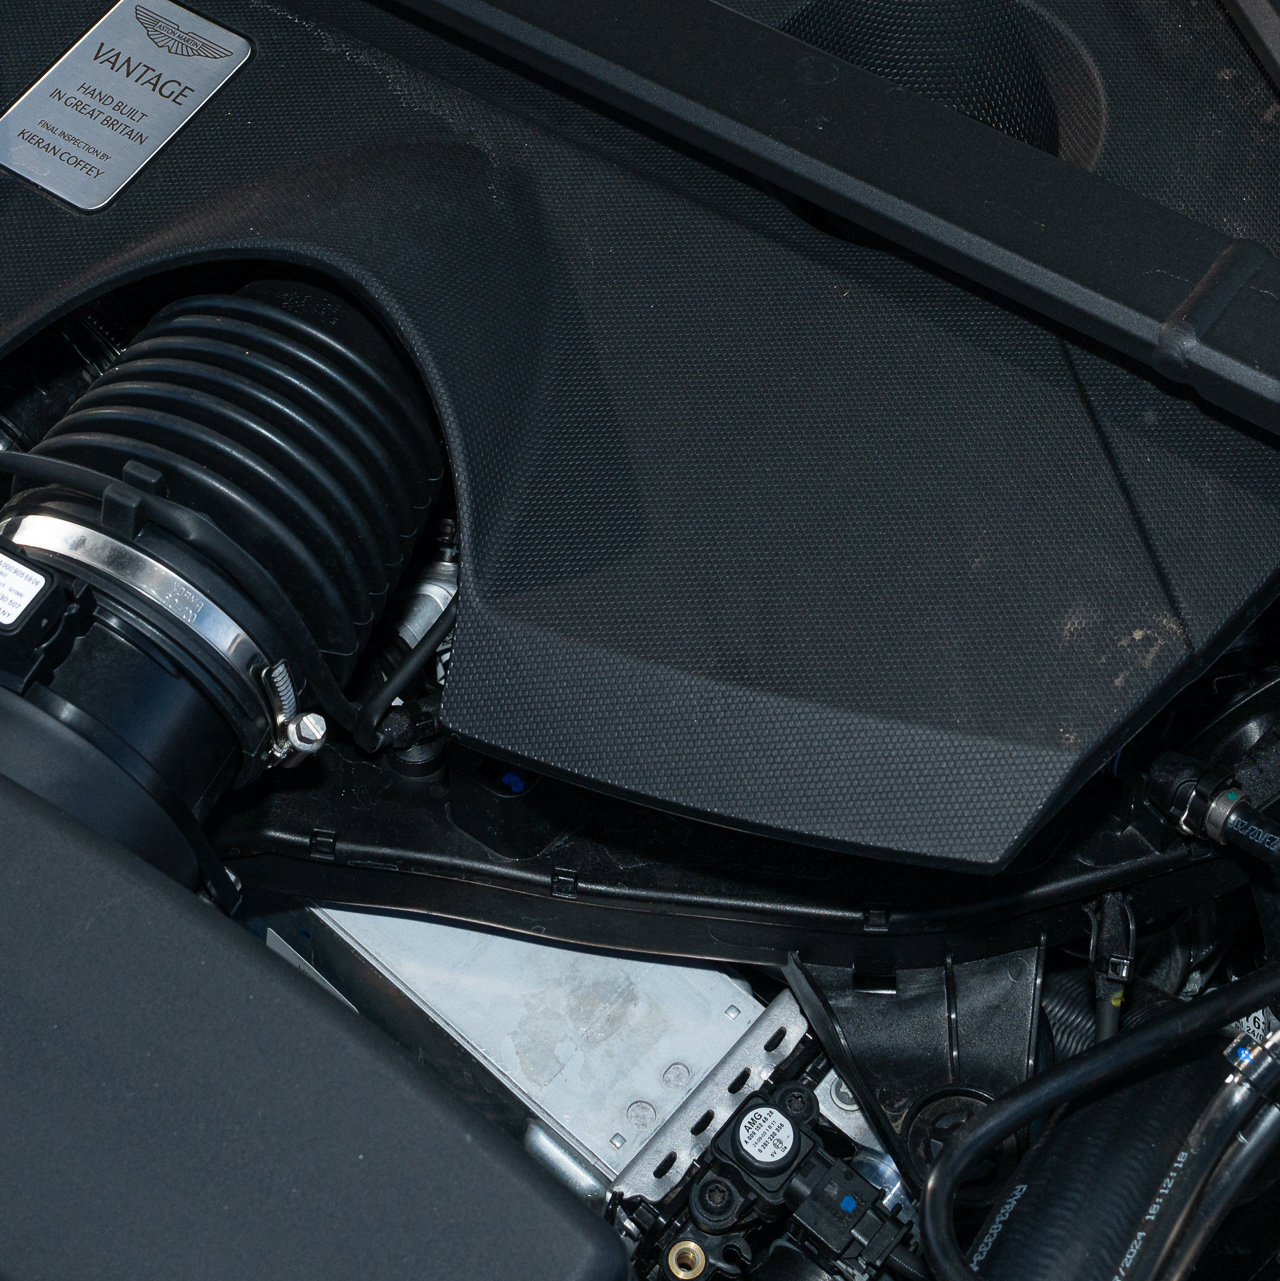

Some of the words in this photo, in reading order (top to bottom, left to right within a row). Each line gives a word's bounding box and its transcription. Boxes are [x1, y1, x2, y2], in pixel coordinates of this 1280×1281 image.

[155, 23, 178, 36] ASTON
[173, 33, 200, 48] MARTIN
[93, 41, 195, 105] VANTAGE
[48, 88, 66, 101] IN
[63, 96, 104, 120] GREAT
[99, 114, 148, 145] BRITAIN
[76, 82, 114, 105] HAND
[111, 100, 148, 122] BUILT
[16, 128, 61, 156] KIERAN
[58, 151, 104, 178] COFFEY
[37, 119, 58, 134] FINAL
[57, 130, 101, 157] INSPECTION
[98, 152, 111, 161] BY
[7, 599, 21, 609] 507
[744, 1112, 762, 1133] AMG
[1145, 1151, 1188, 1221] 18:12:18
